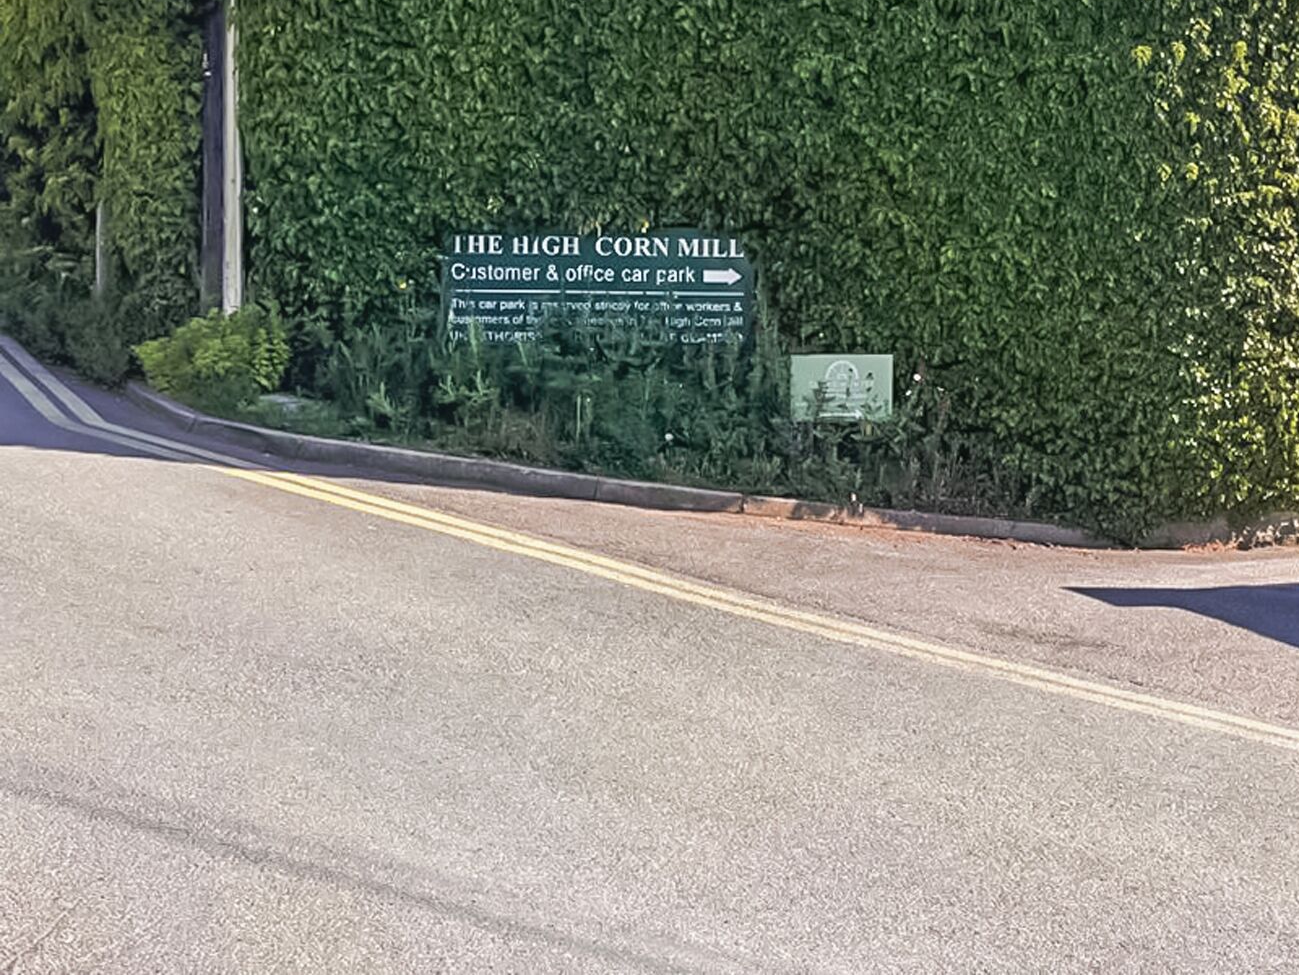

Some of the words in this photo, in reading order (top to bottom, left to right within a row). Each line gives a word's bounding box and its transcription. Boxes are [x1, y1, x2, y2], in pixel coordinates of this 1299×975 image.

[453, 234, 503, 254] THE
[511, 235, 580, 256] HIGH
[595, 236, 670, 257] CORN
[677, 238, 744, 258] MILL
[451, 263, 541, 281] Customer
[546, 264, 559, 281] &
[565, 264, 615, 282] office
[621, 267, 650, 282] car
[656, 266, 695, 285] park
[478, 299, 497, 310] car
[500, 298, 525, 312] park
